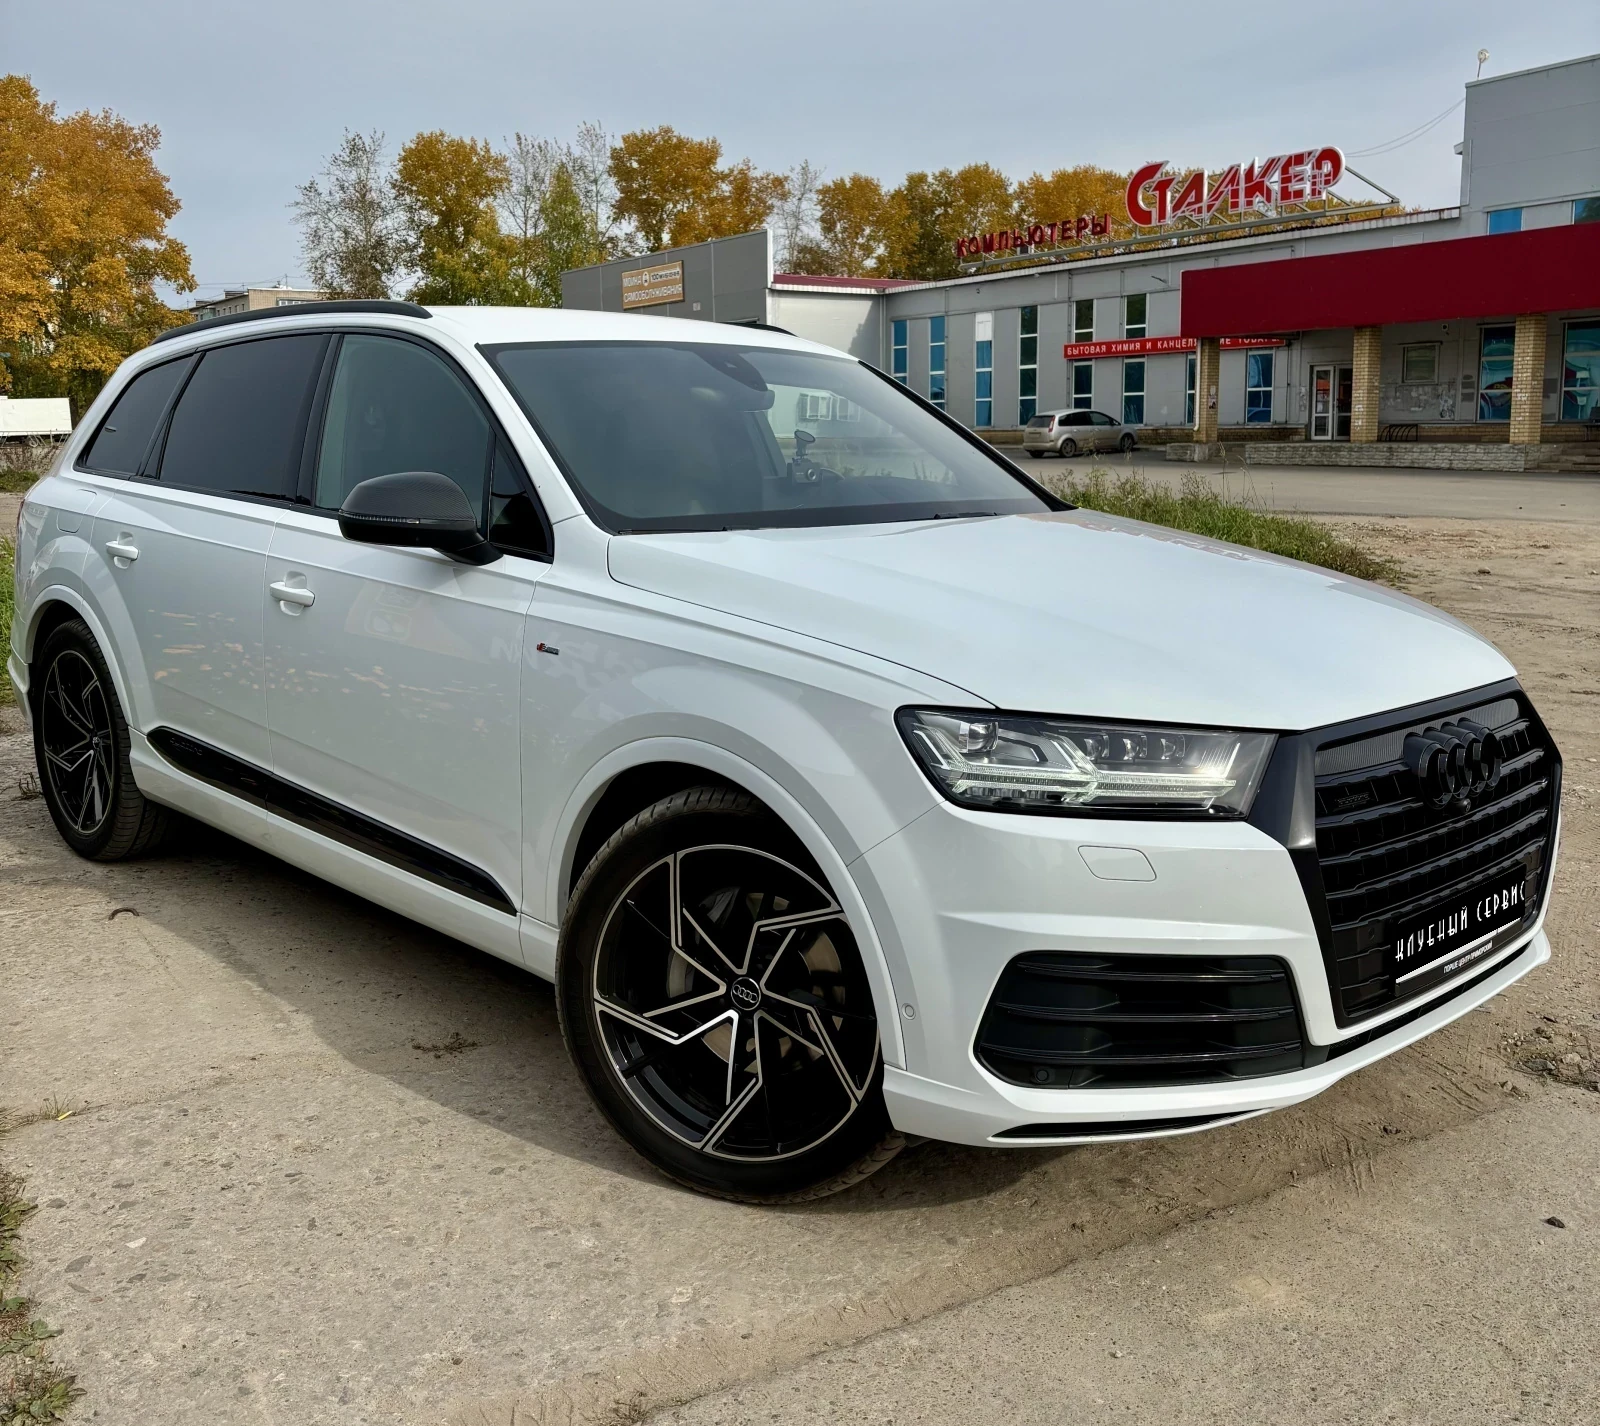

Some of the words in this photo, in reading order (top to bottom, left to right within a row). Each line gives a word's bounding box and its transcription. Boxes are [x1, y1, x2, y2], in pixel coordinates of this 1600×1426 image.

[1125, 145, 1345, 228] СТАЛКЕР
[956, 212, 1111, 258] КОМПЬЮТЕРЫ
[1067, 344, 1106, 355] БЫТОВАЯ
[1111, 342, 1140, 352] ХИМИЯ
[1146, 341, 1151, 350] И
